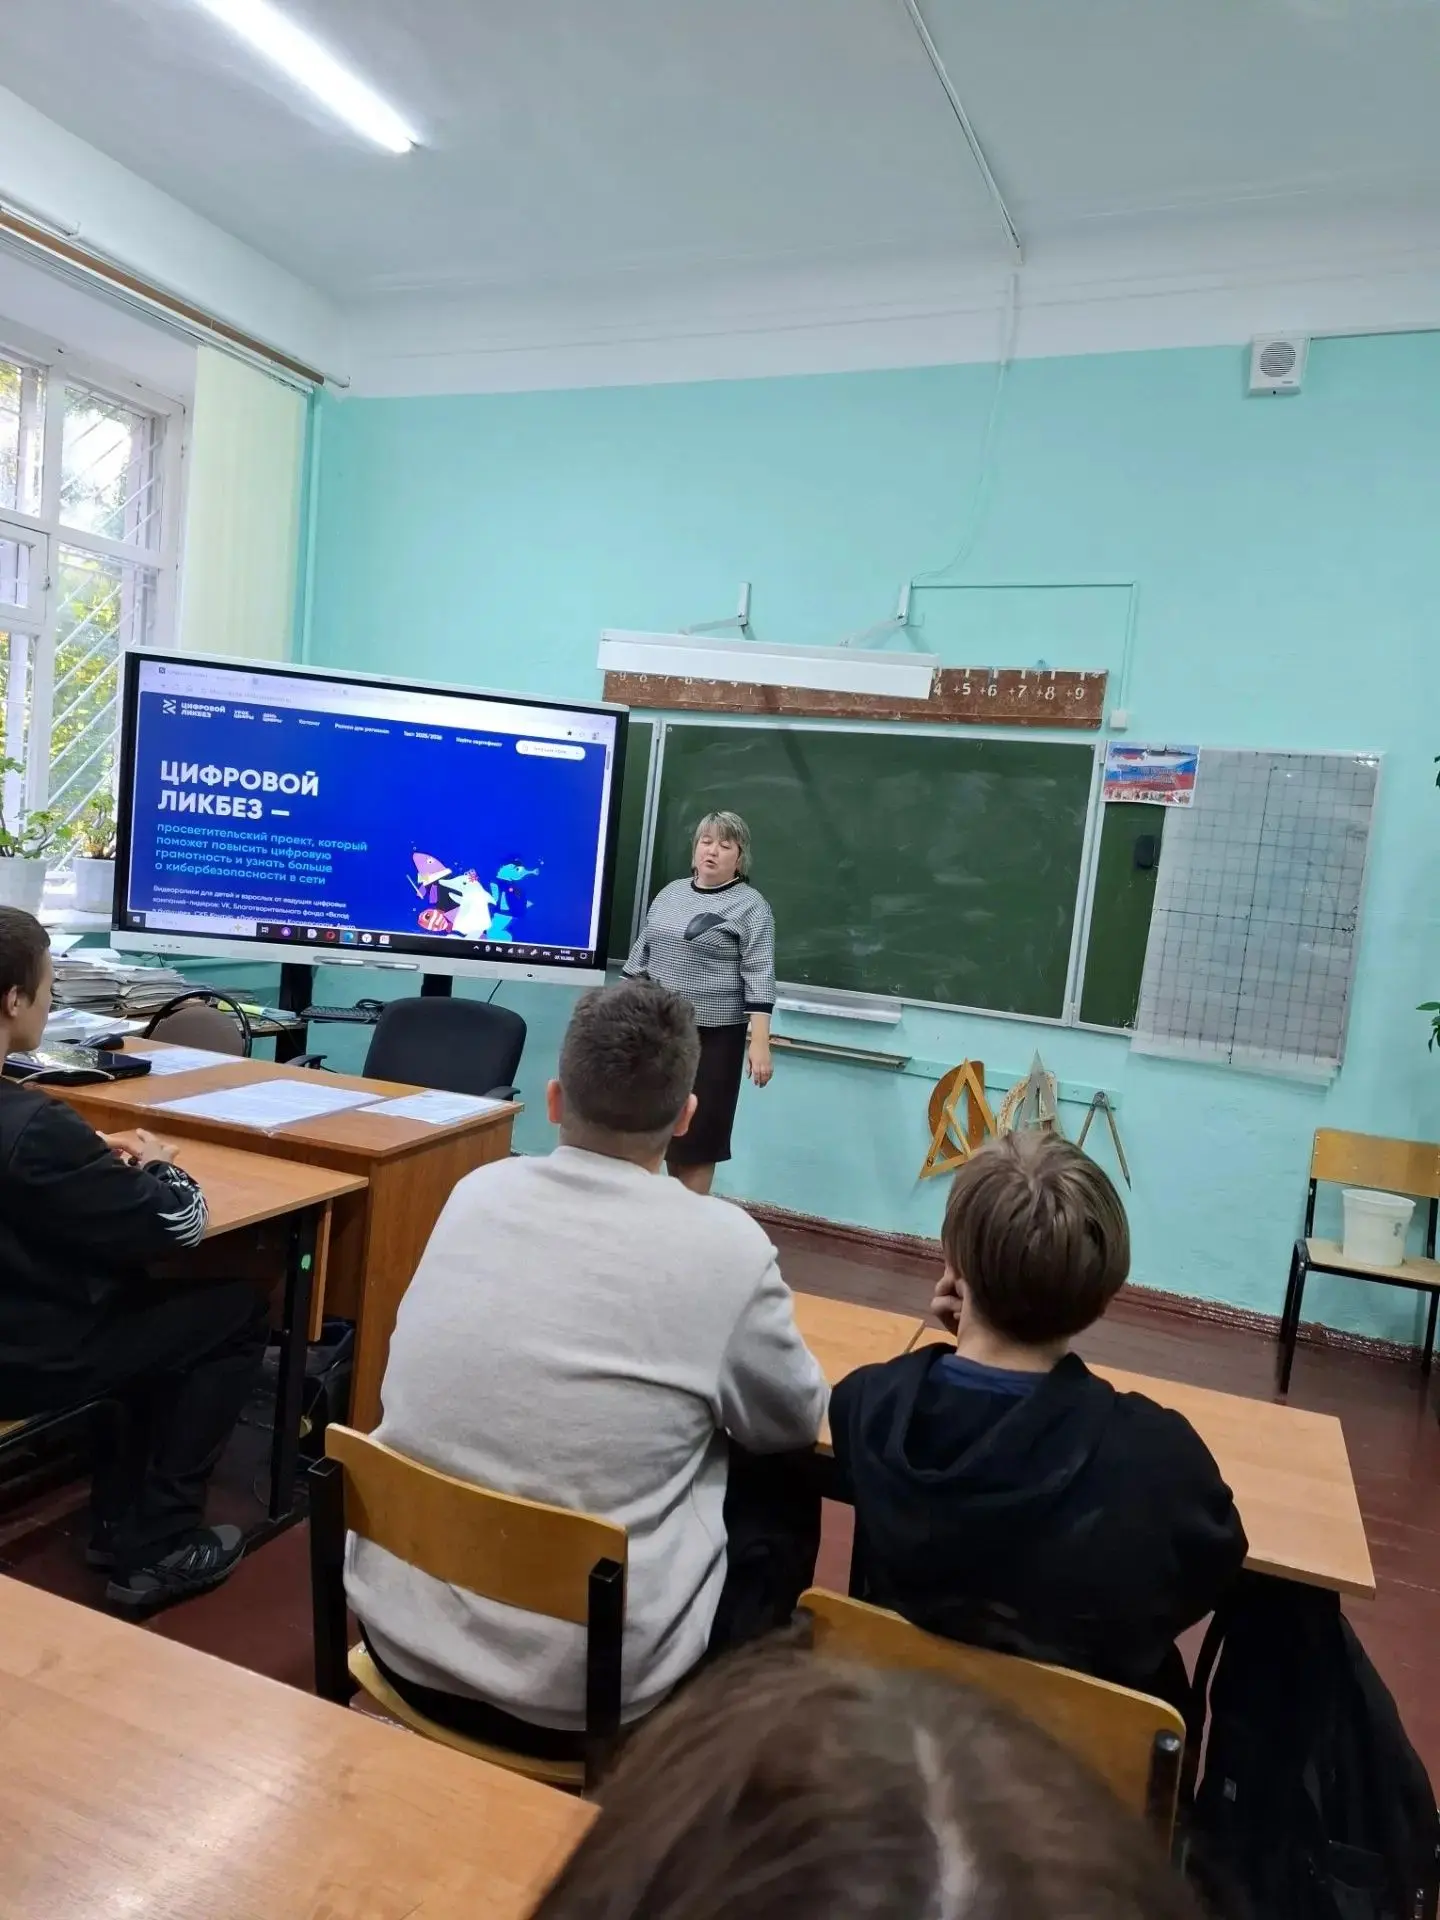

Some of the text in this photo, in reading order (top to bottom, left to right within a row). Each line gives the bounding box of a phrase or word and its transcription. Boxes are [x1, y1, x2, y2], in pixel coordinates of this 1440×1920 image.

[953, 683, 971, 695] +5
[980, 684, 998, 697] +6
[1008, 685, 1027, 698] +7
[1036, 686, 1055, 700] +8
[1065, 687, 1085, 699] +9
[181, 702, 226, 713] ЦИФРОВОЙ
[160, 760, 319, 797] ЦИФРОВОЙ
[157, 790, 263, 820] ЛИКБЕЗ
[156, 836, 332, 862] поможет повысить цифровую
[157, 823, 368, 852] просветительский проект, который
[155, 849, 333, 873] грамотность и узнать больше
[154, 862, 326, 885] о кибербезопасности в сети
[153, 885, 200, 896] Видеоролики
